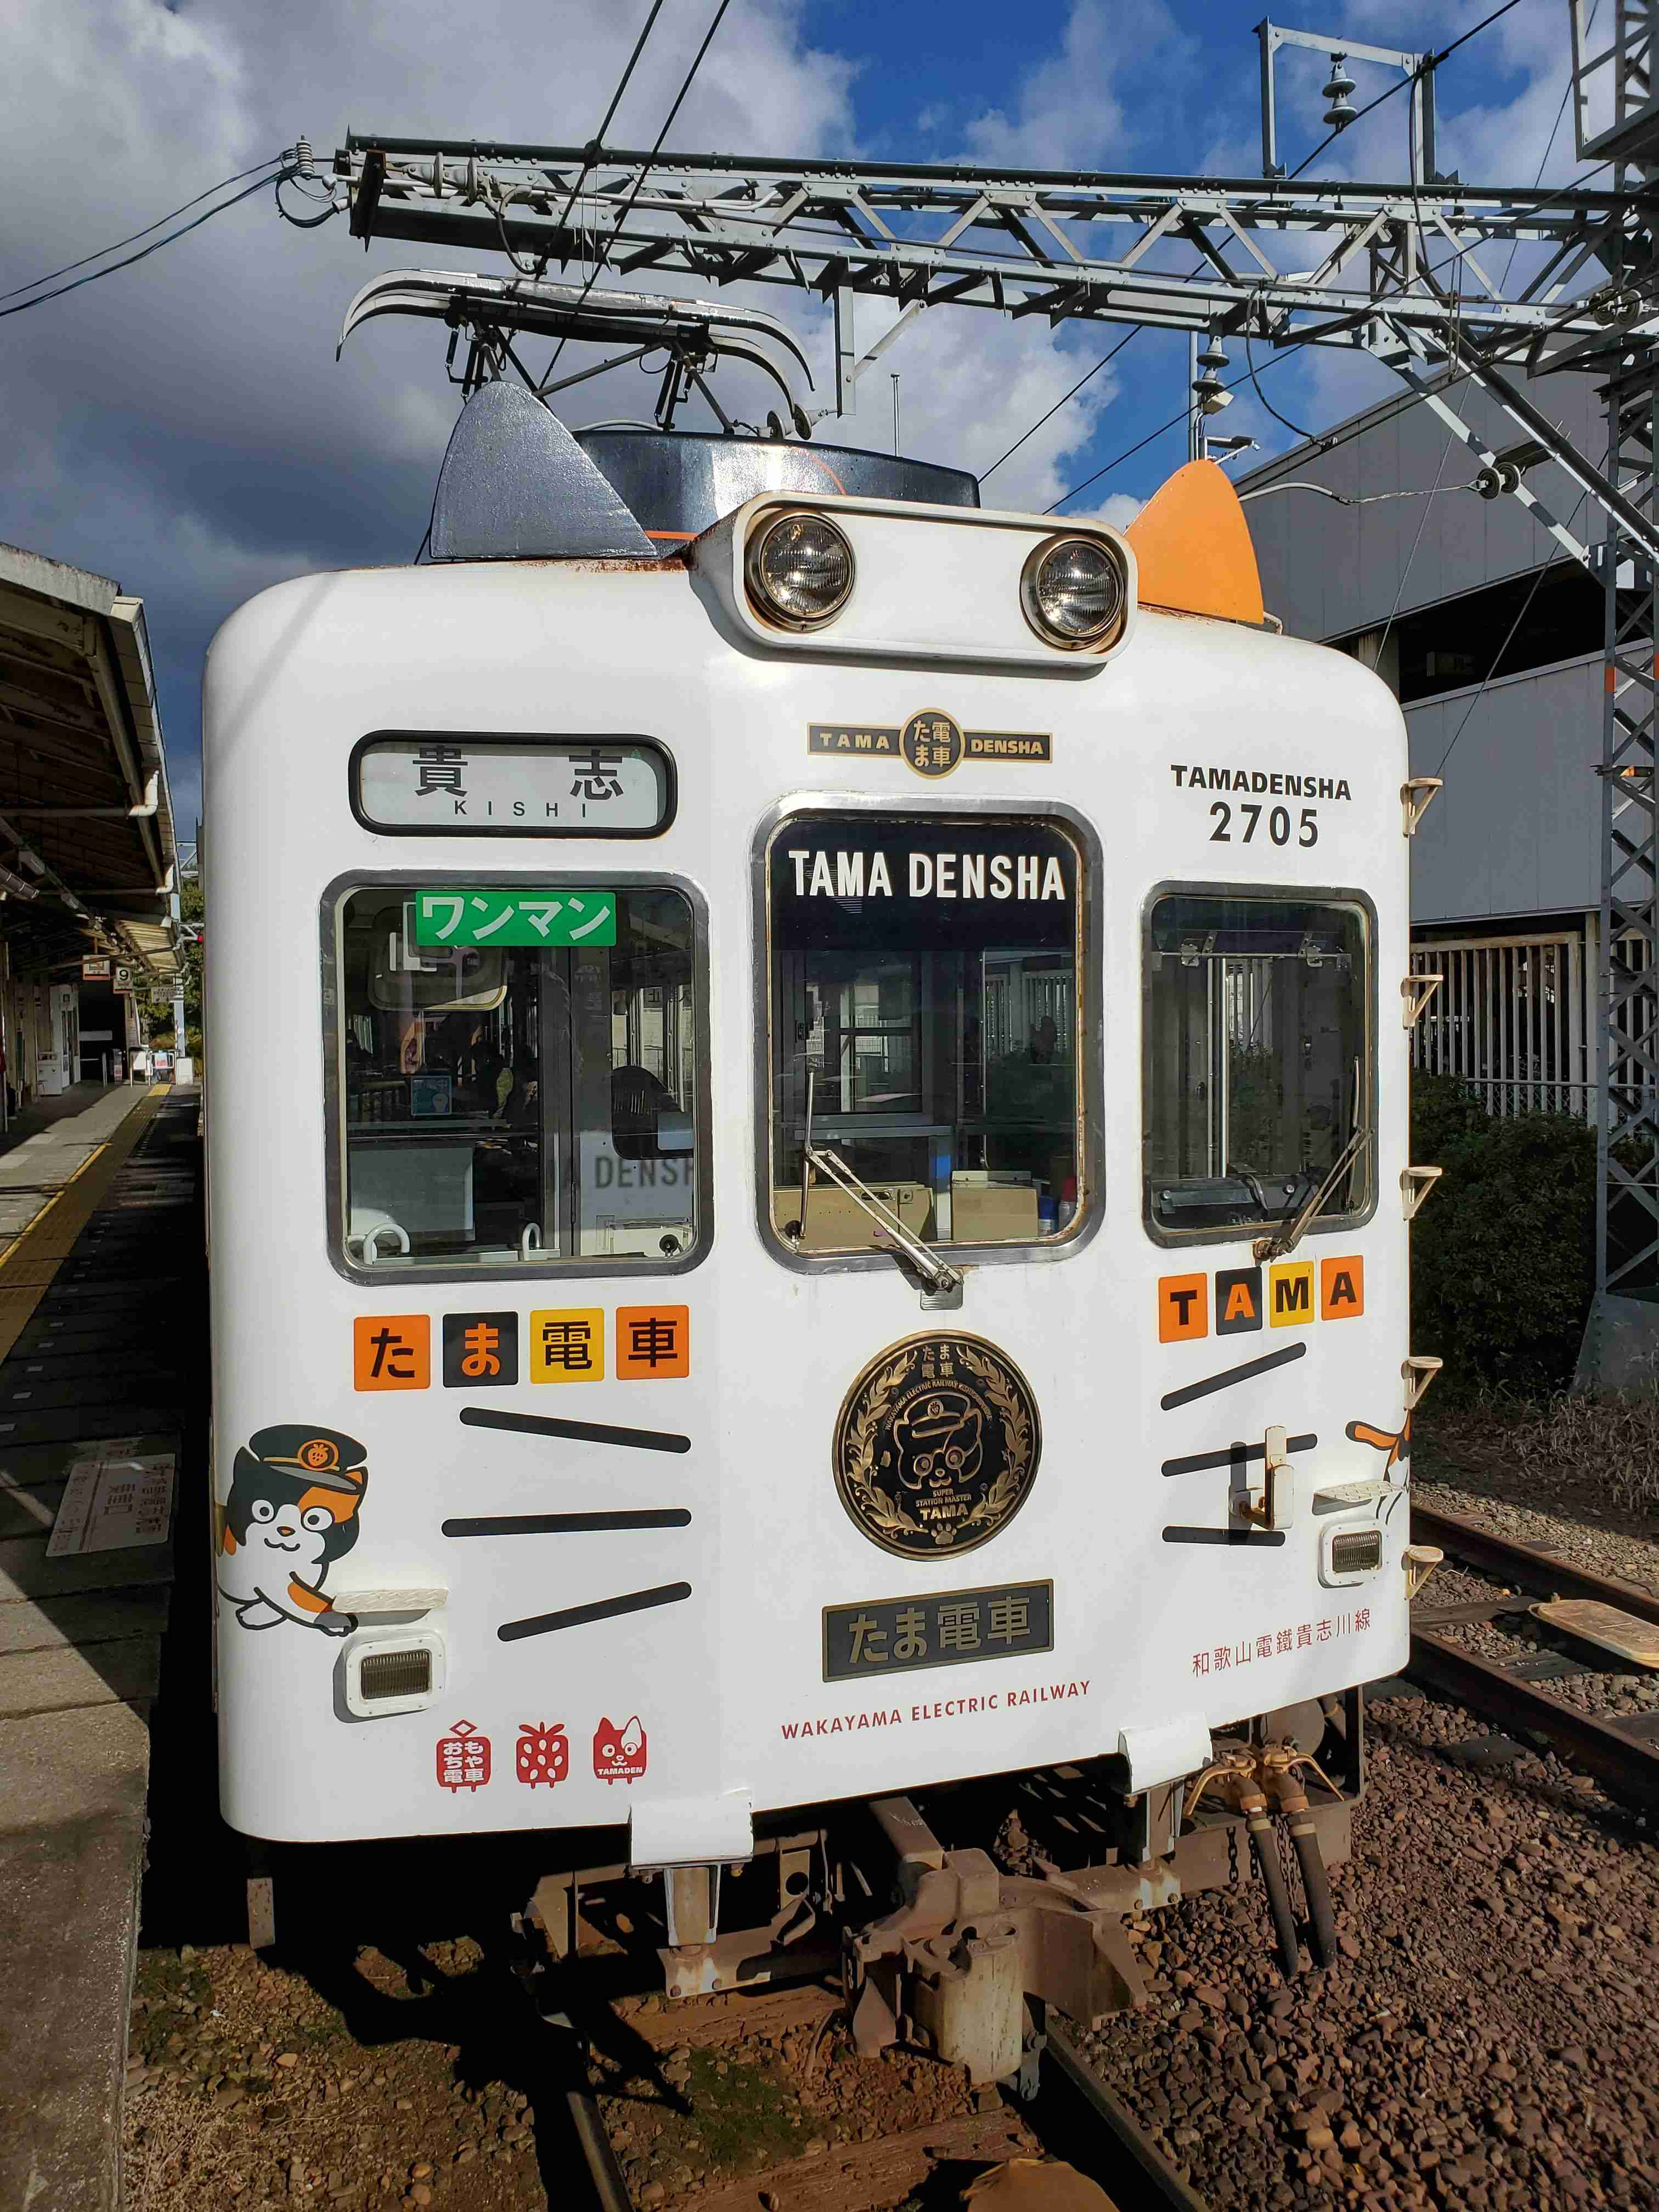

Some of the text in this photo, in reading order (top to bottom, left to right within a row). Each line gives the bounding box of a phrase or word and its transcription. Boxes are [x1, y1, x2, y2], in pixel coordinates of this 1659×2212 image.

[819, 732, 890, 749] TAMA
[970, 739, 1043, 755] DENSHA
[412, 744, 624, 801] 貴志
[1171, 765, 1351, 800] TAMADENSHA
[1209, 801, 1319, 848] 2705
[788, 850, 1066, 900] TAMA DENSHA
[421, 896, 611, 940] ワンマン
[1170, 1271, 1357, 1326] TAMA
[370, 1317, 678, 1378] たま電車
[907, 1382, 932, 1400] ELECTRIC
[916, 1494, 972, 1507] STATION MASTER
[919, 1503, 969, 1521] TAMA
[933, 1488, 954, 1497] SUPER
[848, 1595, 1031, 1663] たま電車
[1192, 1608, 1371, 1677] 和歌山電鐵貴志川線
[781, 1679, 1091, 1740] WAKAYAMA ELECTRIC RAILWAY
[597, 1767, 642, 1775] TAMADEN
